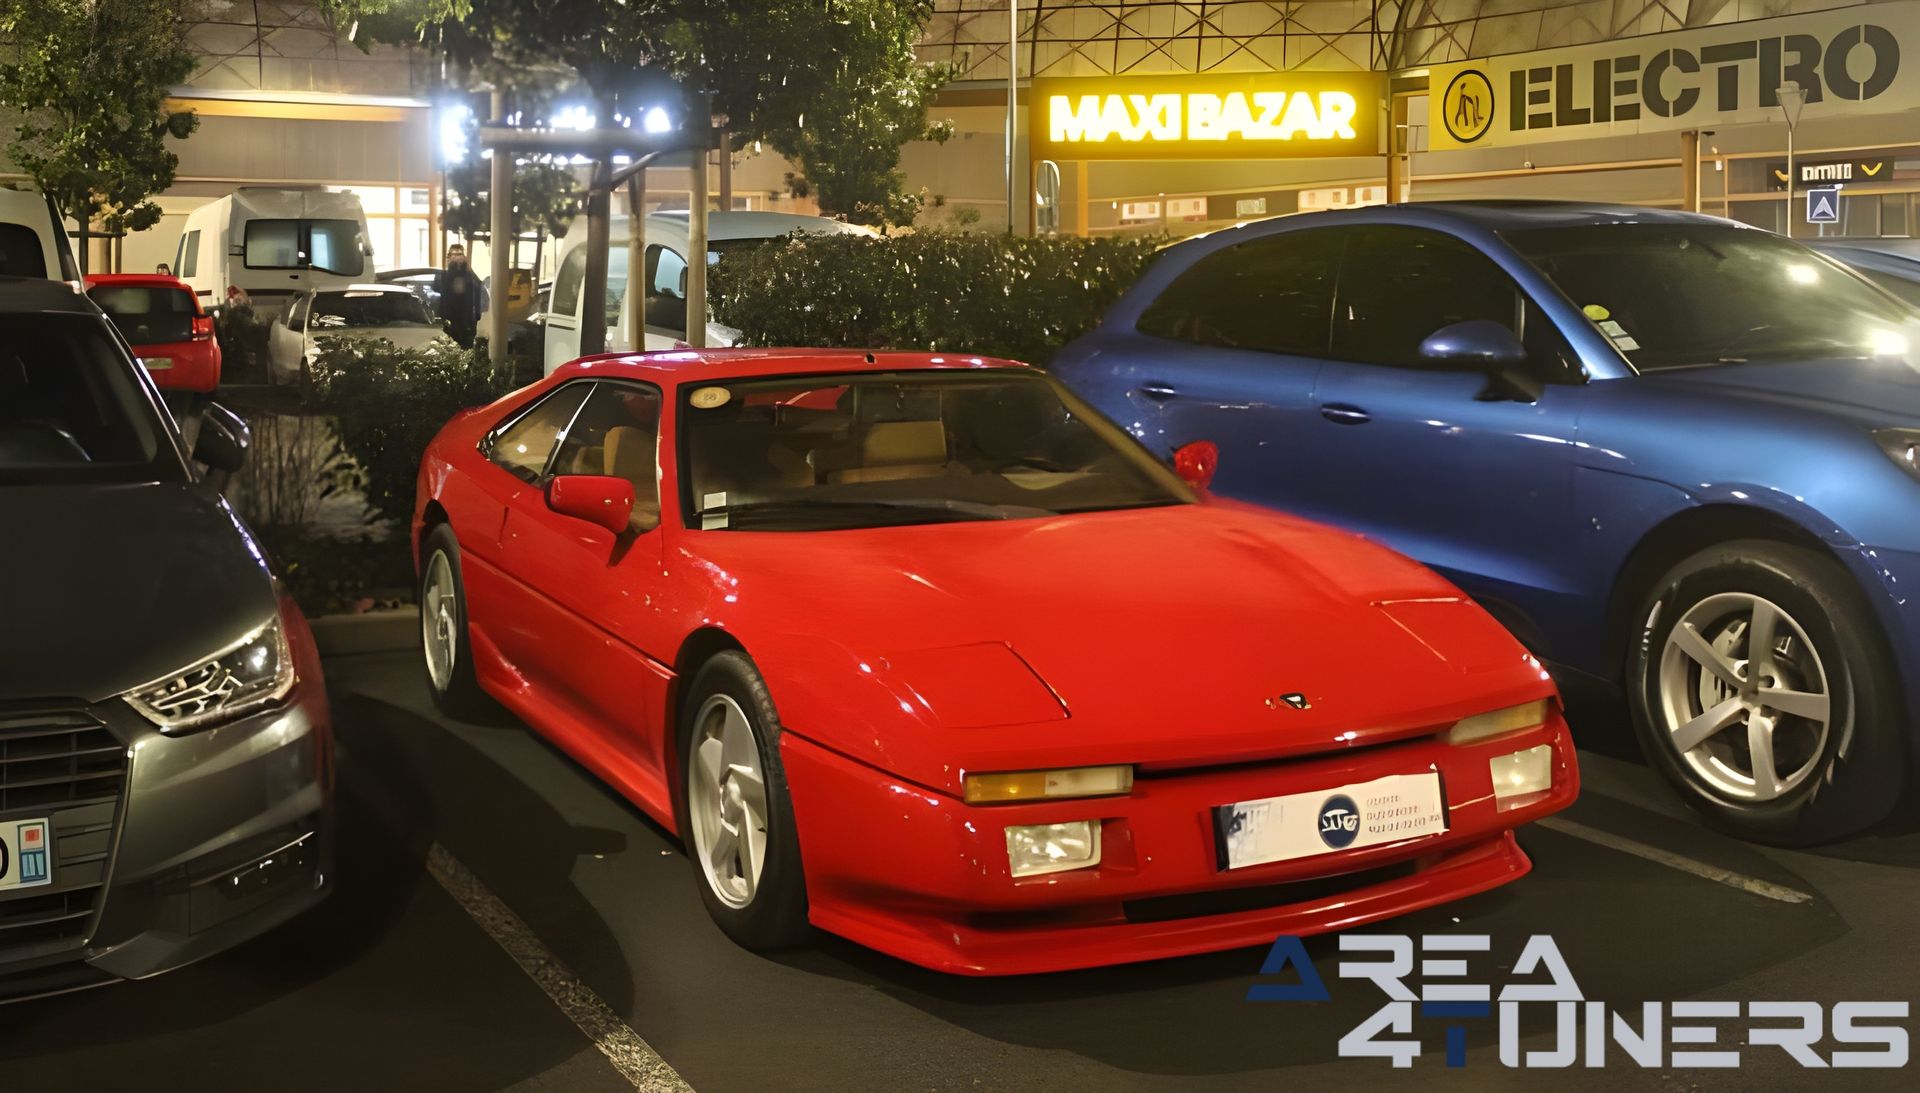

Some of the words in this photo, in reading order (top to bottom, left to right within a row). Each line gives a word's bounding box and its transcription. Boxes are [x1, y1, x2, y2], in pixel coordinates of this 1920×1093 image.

[1049, 93, 1182, 142] MAXI
[1187, 91, 1357, 141] BAZAR
[1509, 24, 1901, 131] ELECTRO
